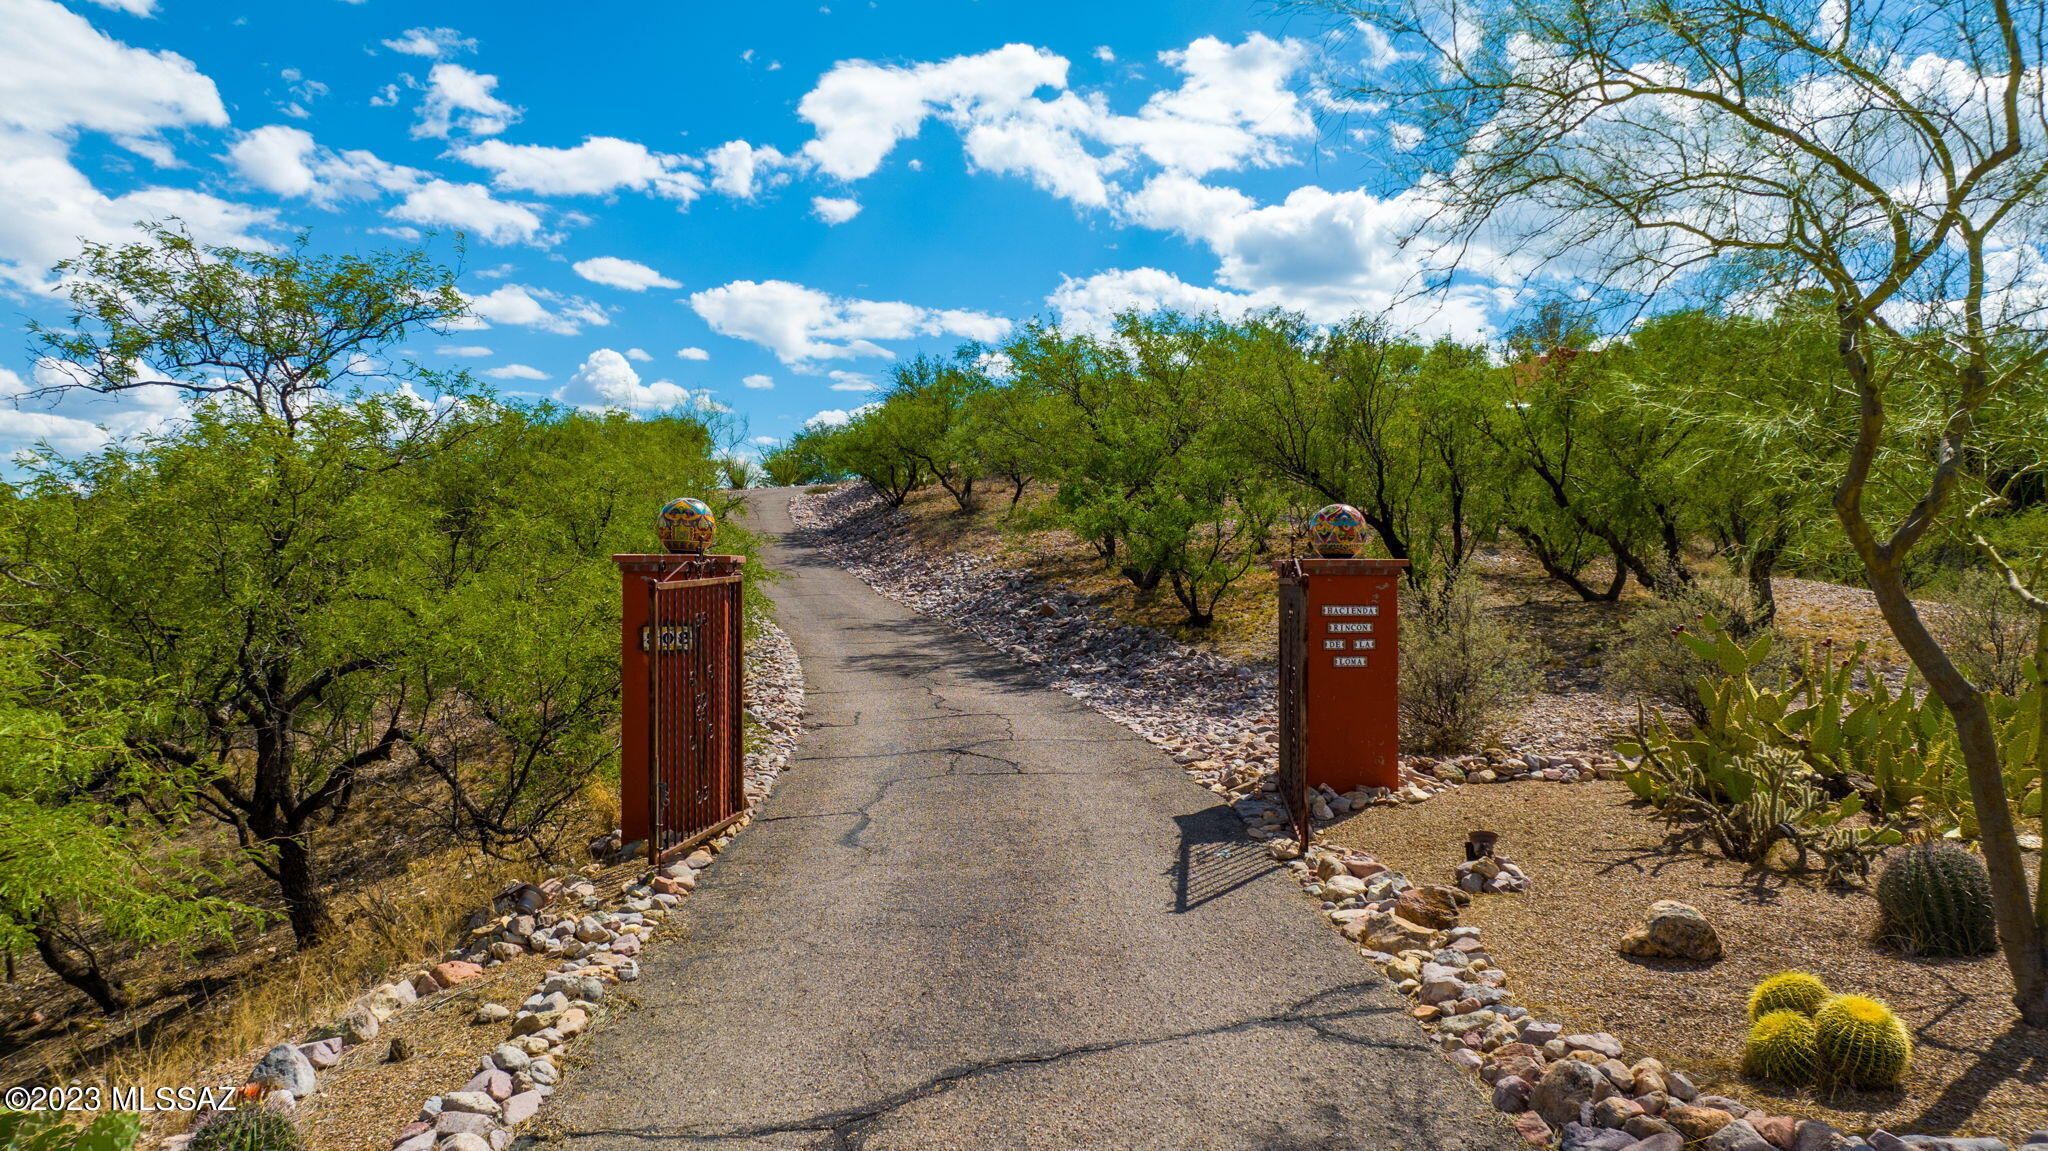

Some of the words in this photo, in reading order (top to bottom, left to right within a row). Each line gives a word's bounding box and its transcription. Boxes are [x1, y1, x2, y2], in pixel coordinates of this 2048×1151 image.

[1326, 606, 1375, 616] HACIENDA
[1332, 623, 1369, 632] RINCON
[1328, 641, 1342, 649] DE
[1358, 641, 1372, 649] LA
[1339, 658, 1363, 666] LOMA
